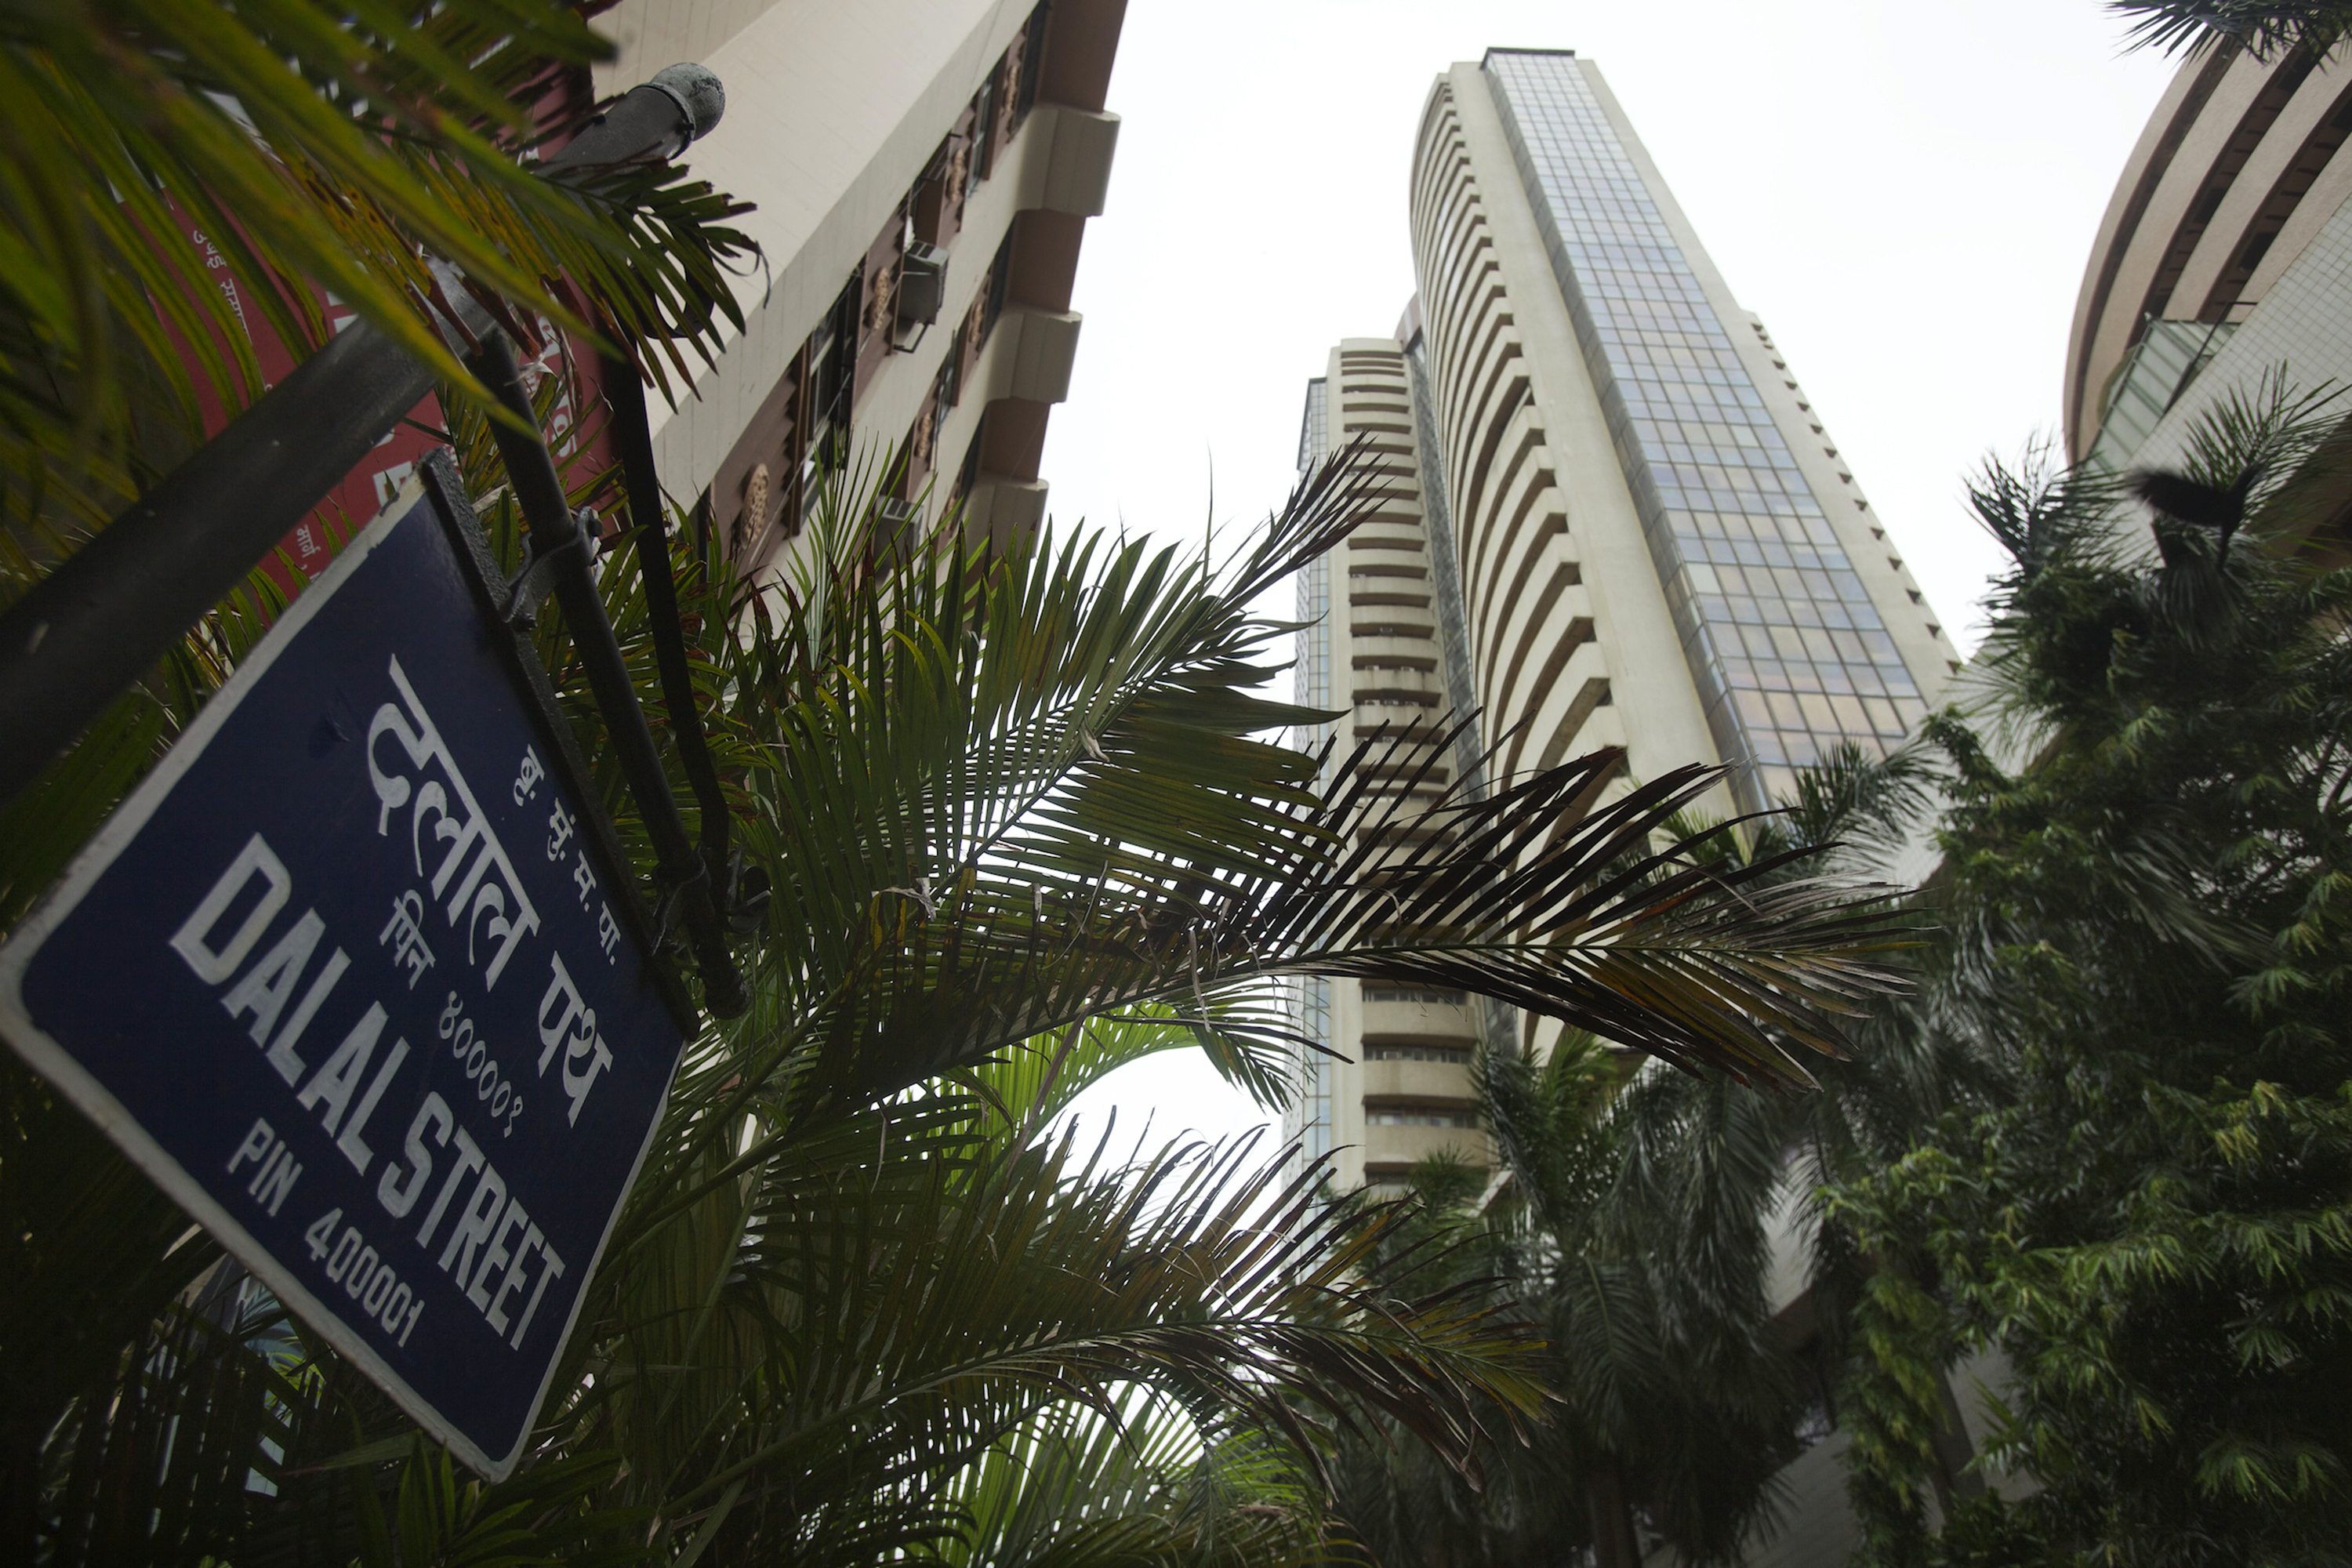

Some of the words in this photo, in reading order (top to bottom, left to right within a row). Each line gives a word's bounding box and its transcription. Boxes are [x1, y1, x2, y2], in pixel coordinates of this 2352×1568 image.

[366, 653, 541, 993] दलाल
[537, 950, 614, 1128] पथ
[379, 889, 436, 990] पिन
[439, 990, 523, 1138] ४००००१
[573, 849, 597, 913] म.
[599, 901, 621, 966] पा.
[169, 832, 411, 1176] DALAL
[377, 1091, 566, 1351] STREET
[227, 1117, 303, 1217] PIN
[305, 1207, 425, 1348] 400001
